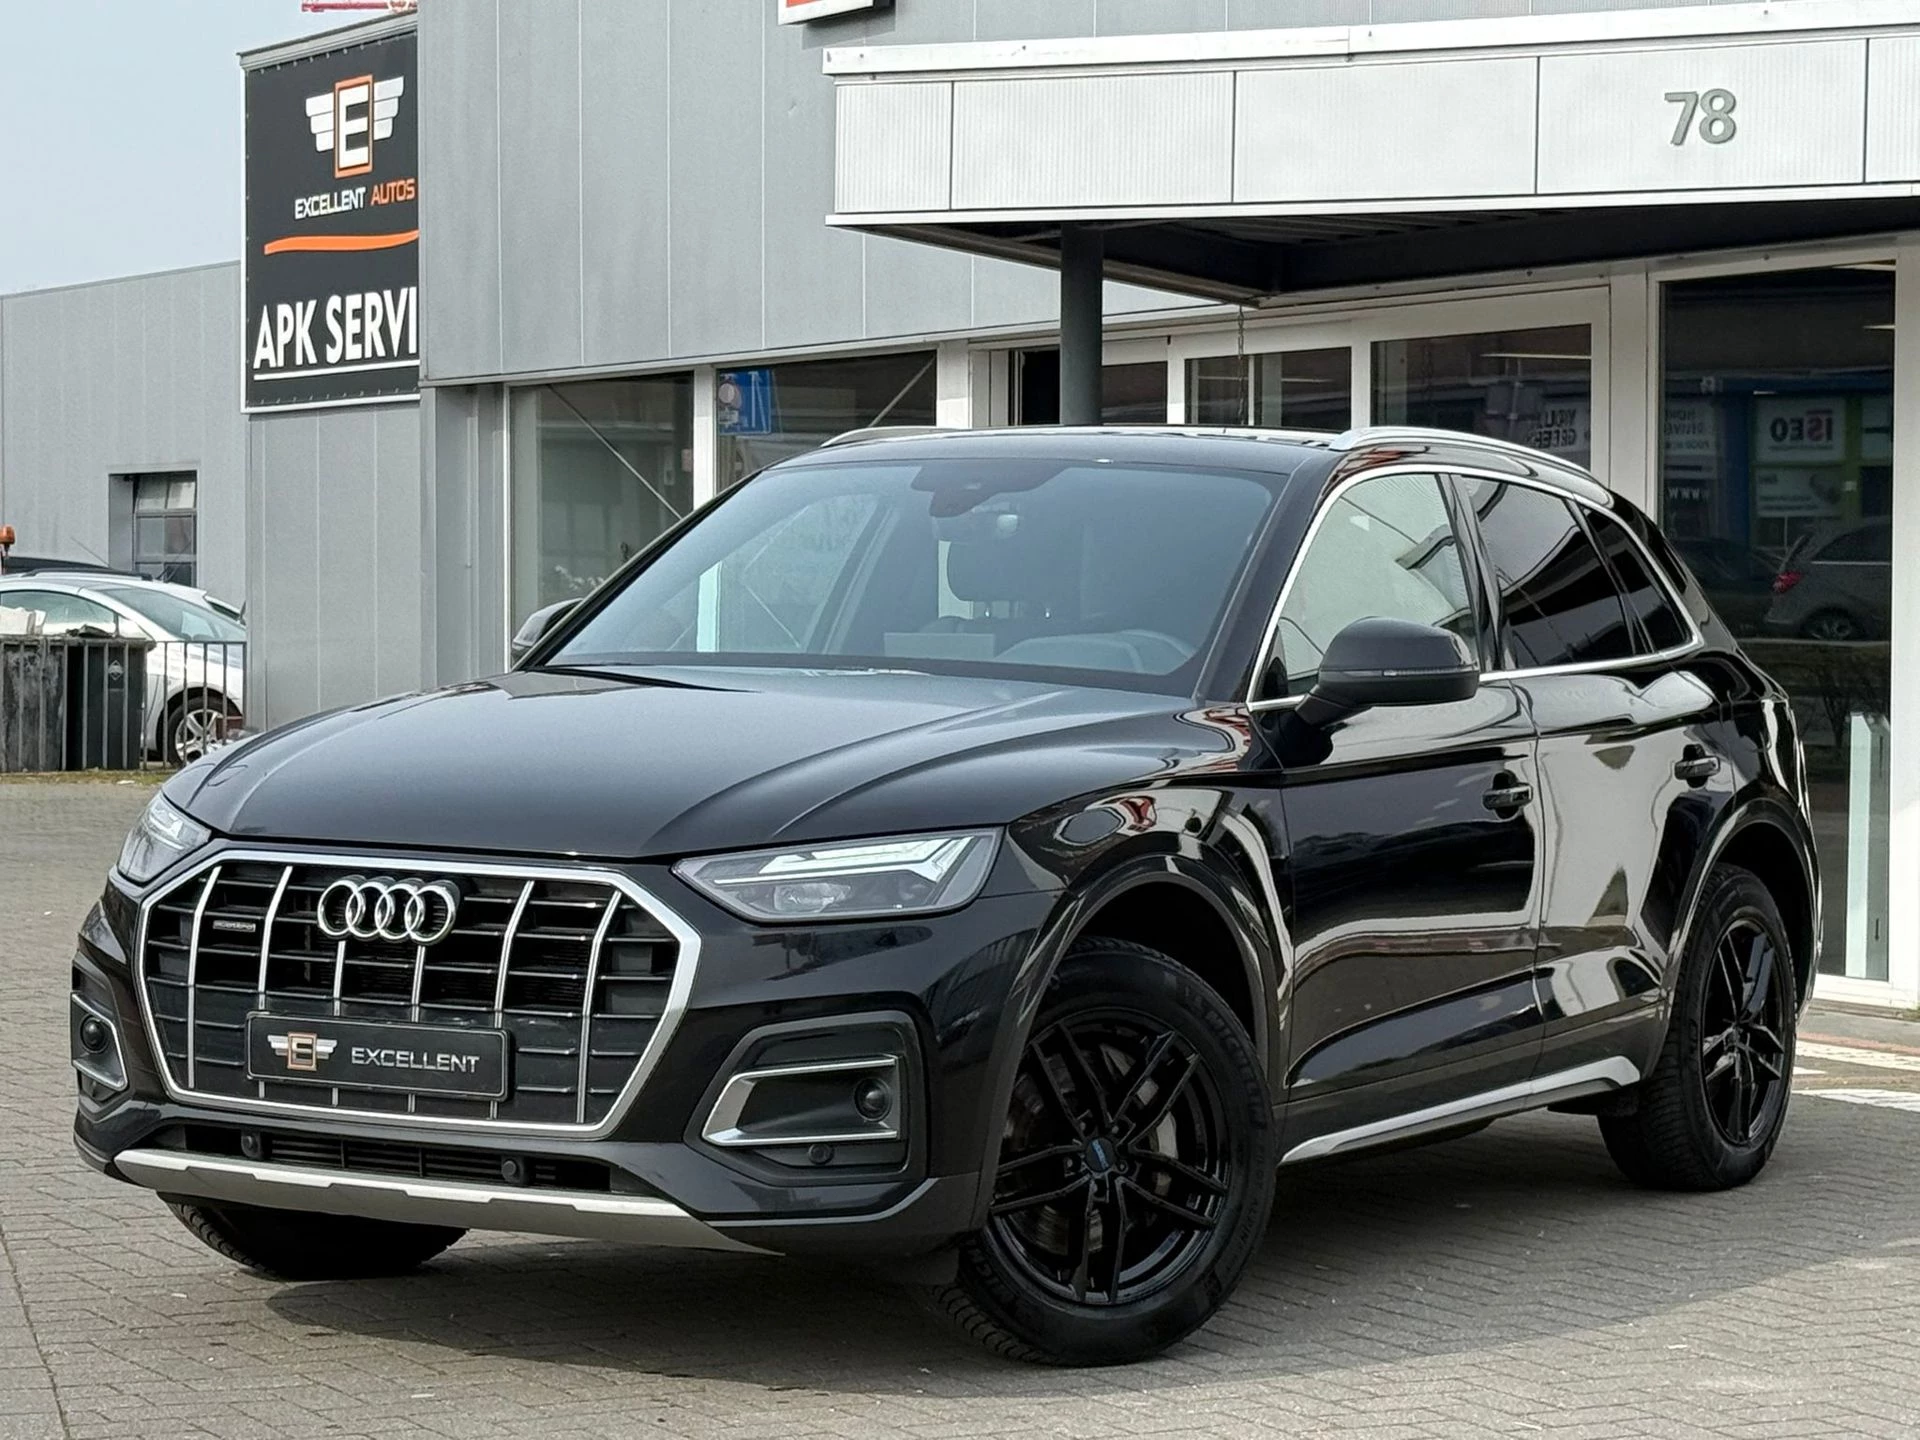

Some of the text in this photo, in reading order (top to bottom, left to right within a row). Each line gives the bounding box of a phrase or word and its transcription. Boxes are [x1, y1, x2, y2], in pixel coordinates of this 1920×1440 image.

[1664, 88, 1737, 146] 78
[294, 178, 416, 220] EXCELLENT AUTOS
[253, 286, 418, 370] APK SERVI
[351, 1046, 480, 1073] EXCELLENT
